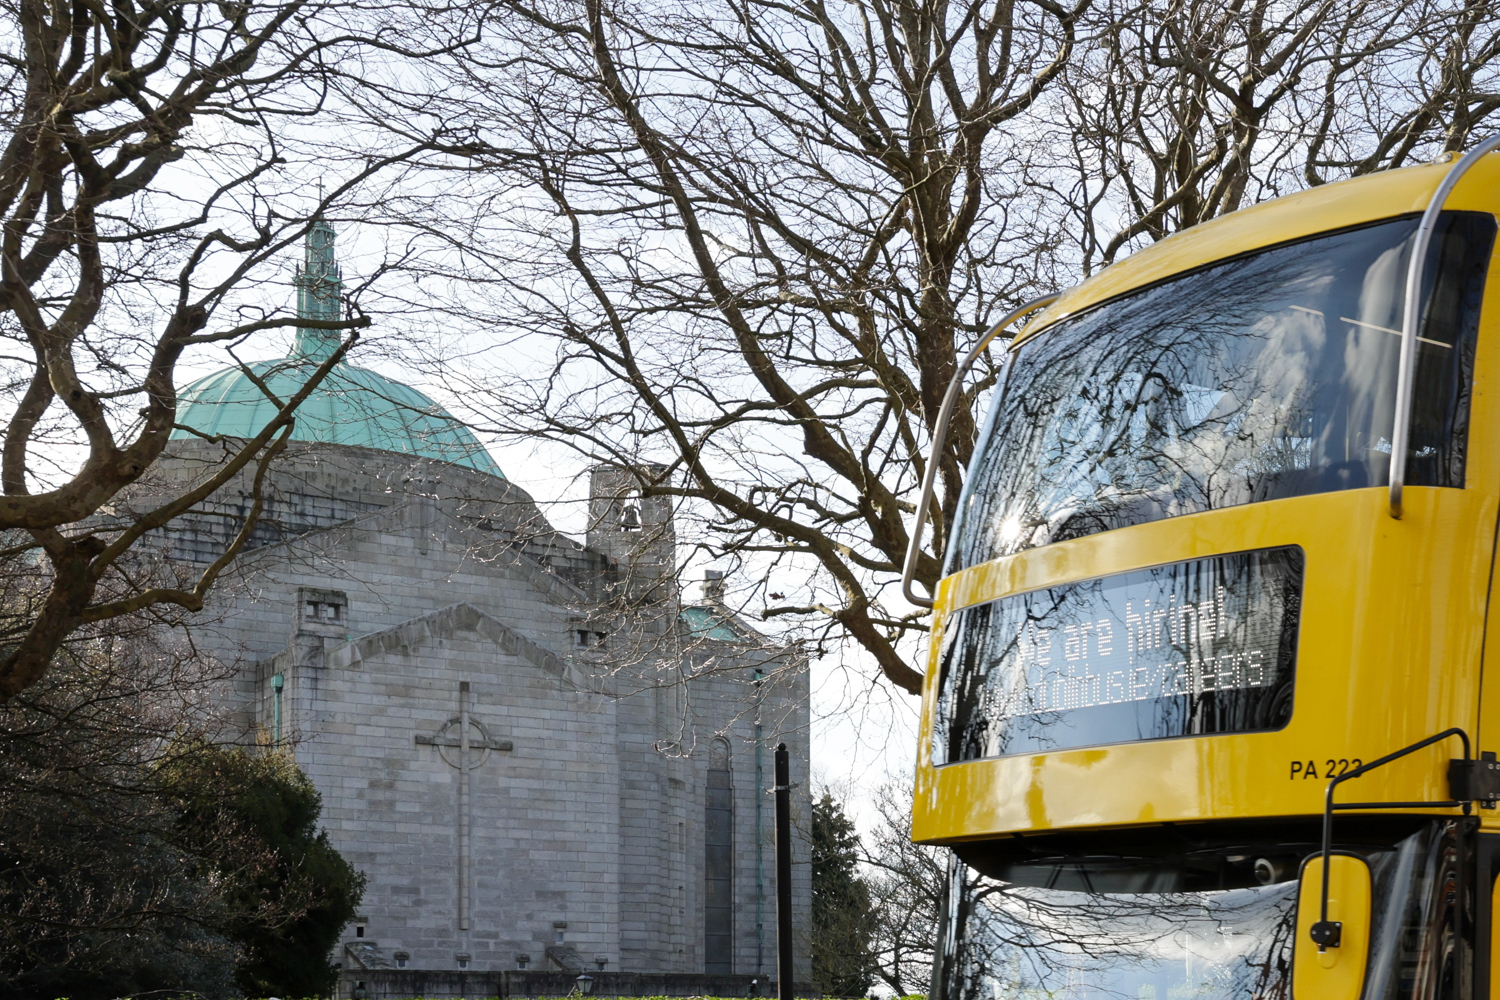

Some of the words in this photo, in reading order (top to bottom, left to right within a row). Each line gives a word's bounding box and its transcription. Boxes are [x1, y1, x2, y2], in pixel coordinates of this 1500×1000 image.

[1017, 619, 1051, 667] We
[1063, 618, 1114, 662] are
[1126, 585, 1226, 652] hiring!
[1289, 760, 1319, 780] PA
